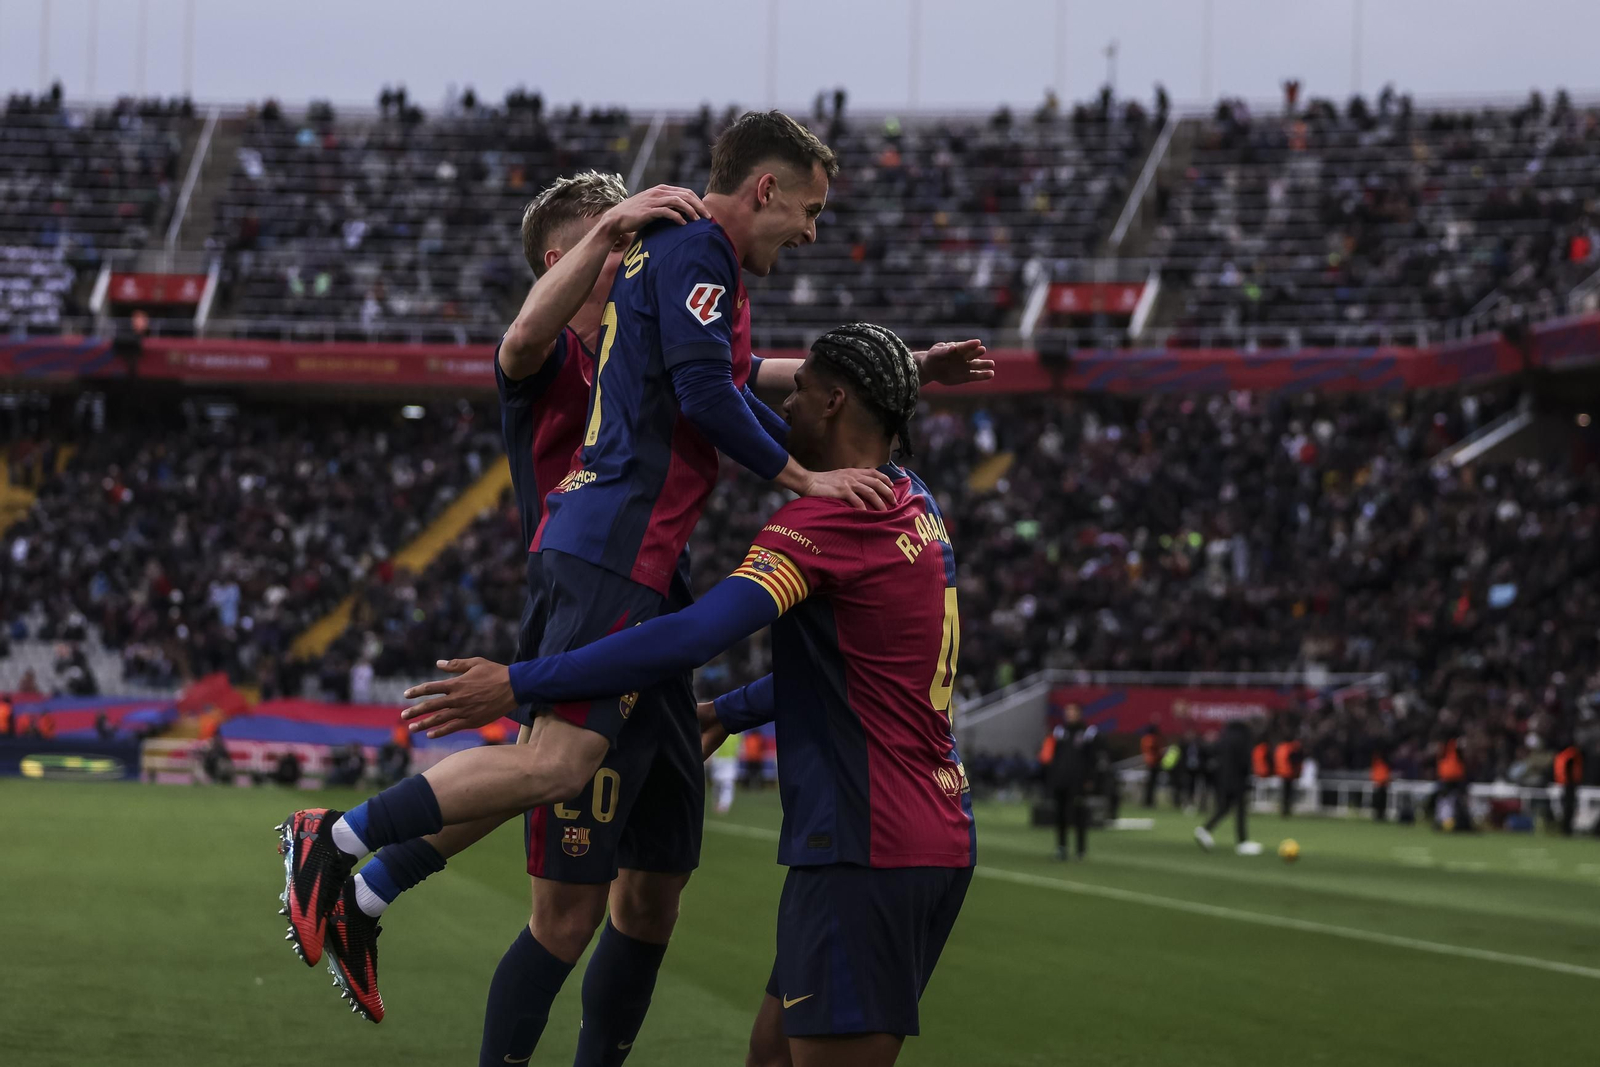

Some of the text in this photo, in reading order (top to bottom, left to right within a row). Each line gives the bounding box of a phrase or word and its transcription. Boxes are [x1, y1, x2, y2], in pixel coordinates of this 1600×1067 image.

[761, 524, 813, 548] AMBILIGHT
[914, 512, 953, 551] ARAU
[929, 586, 960, 727] 4
